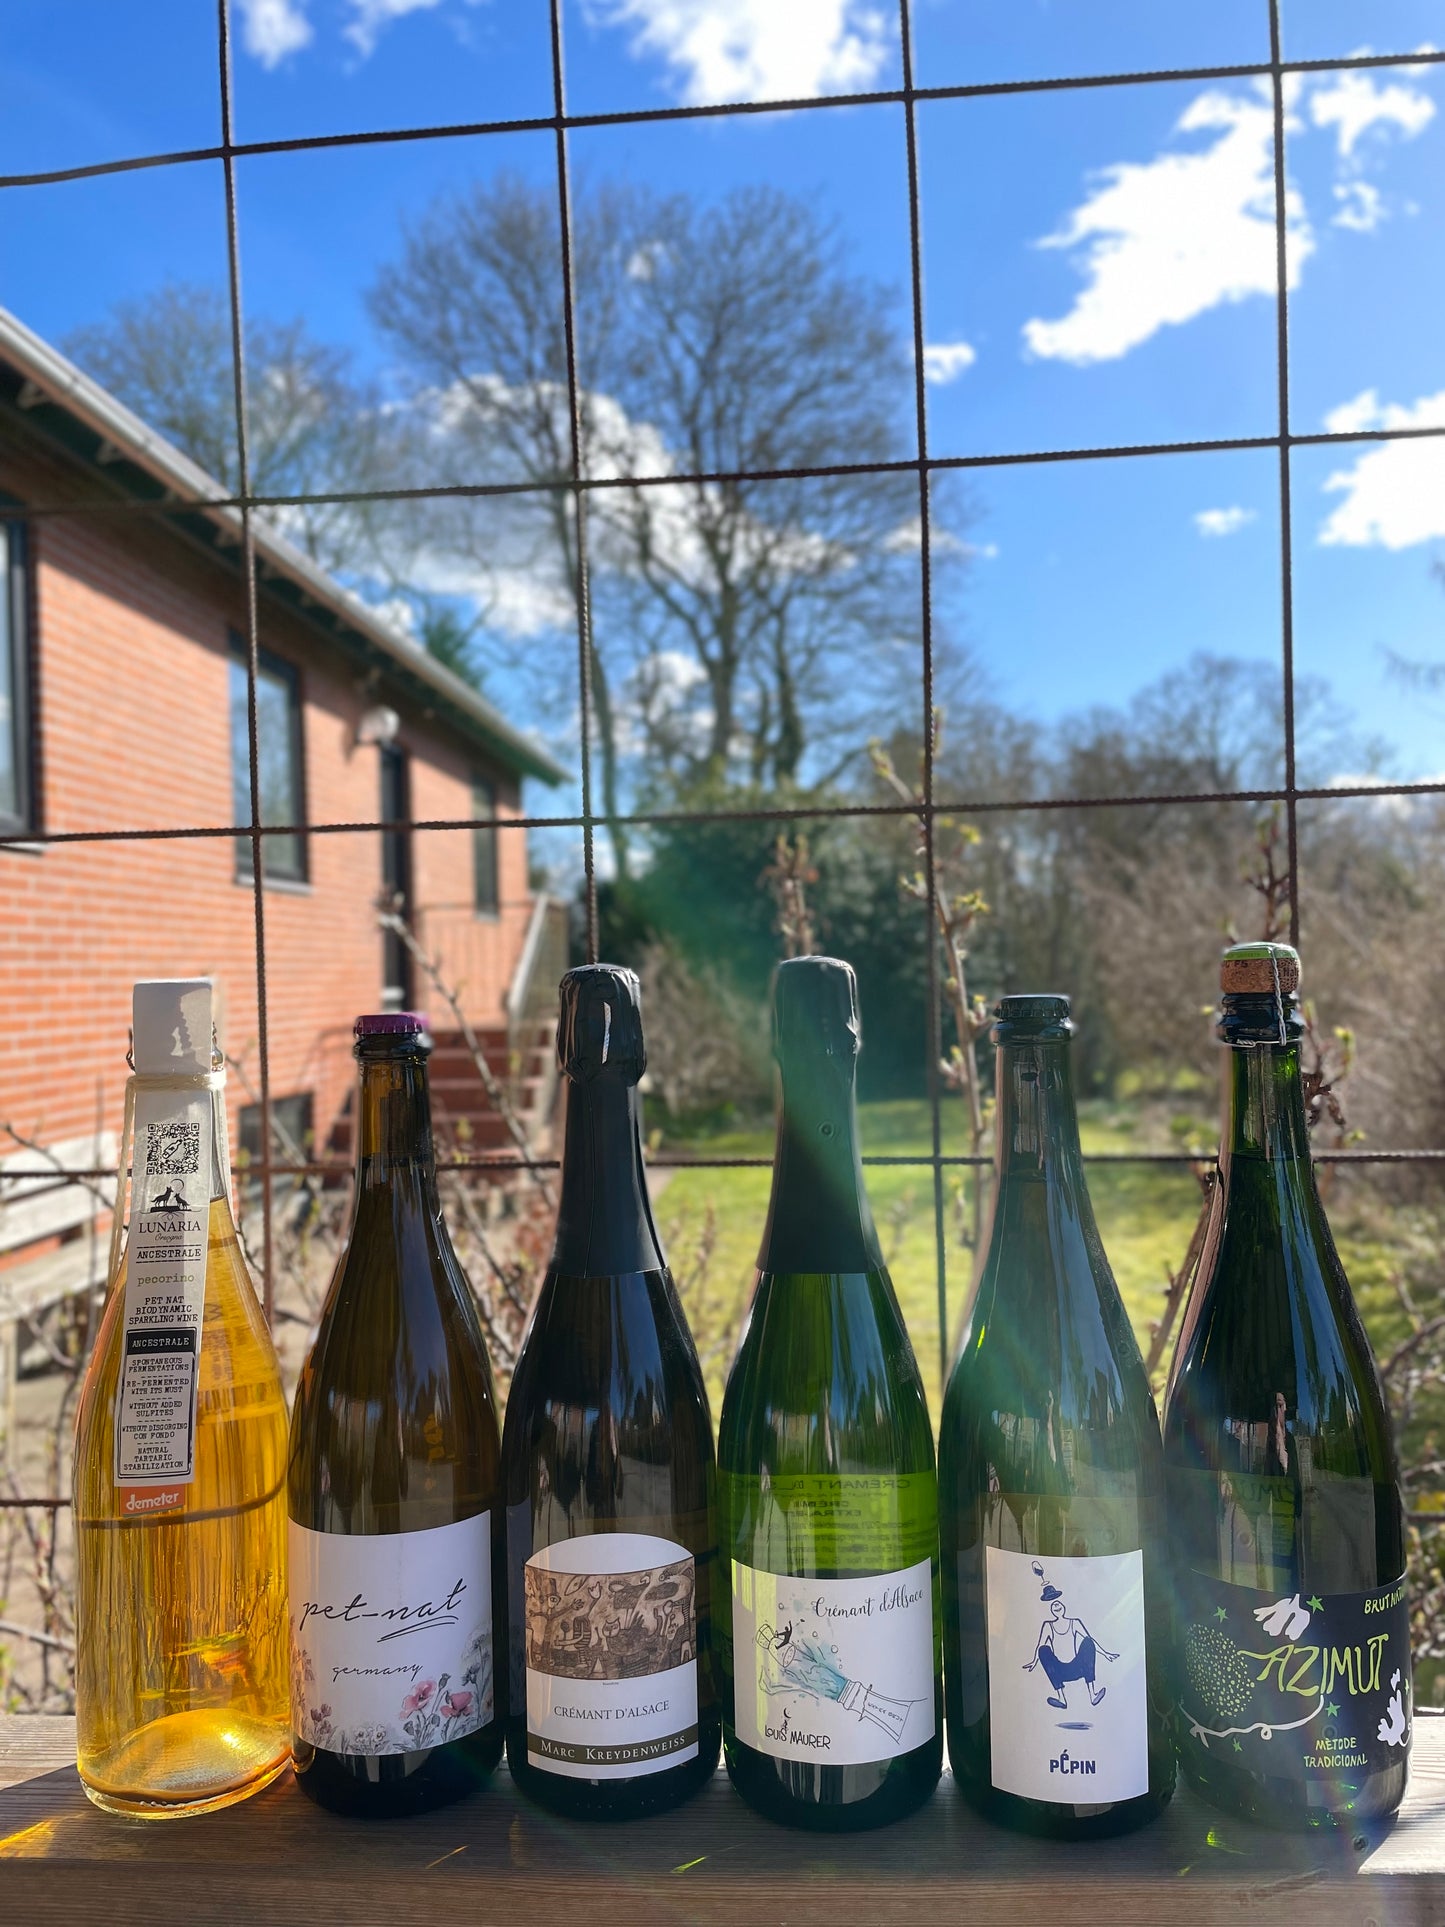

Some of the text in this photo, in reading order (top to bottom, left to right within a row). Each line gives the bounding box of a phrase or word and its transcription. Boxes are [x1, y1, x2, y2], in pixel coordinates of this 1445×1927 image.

[138, 1221, 201, 1233] LUNARIA
[137, 1249, 201, 1259] ANCESTRALE
[137, 1273, 194, 1287] pecorino
[145, 1296, 184, 1305] PET NAT
[136, 1305, 192, 1315] BIODYNAMIC
[129, 1314, 198, 1325] SPARKLING WINE
[132, 1337, 190, 1347] ANCESTRALE
[132, 1358, 183, 1366] SPONTANEOUS
[128, 1364, 189, 1373] FERMENTATIONS
[126, 1378, 190, 1387] RE-FERMENTED
[136, 1409, 174, 1417] SULFITES
[148, 1423, 188, 1431] DISGORGING
[133, 1431, 175, 1440] CON FONDO
[137, 1446, 169, 1454] NATURAL
[134, 1454, 173, 1462] TARTARIC
[123, 1461, 184, 1470] STABILIZATION
[126, 1492, 179, 1510] demeter
[300, 1578, 467, 1631] pet-nat
[811, 1584, 923, 1618] Crémant d'Alsace
[1364, 1594, 1390, 1614] BRUT
[1237, 1633, 1388, 1696] AZIMUT
[333, 1663, 423, 1682] germany
[554, 1700, 670, 1720] CRÉMANT D'ALSACE
[764, 1725, 831, 1749] LOUIS MAURER
[1303, 1753, 1368, 1768] TRADICIONAL
